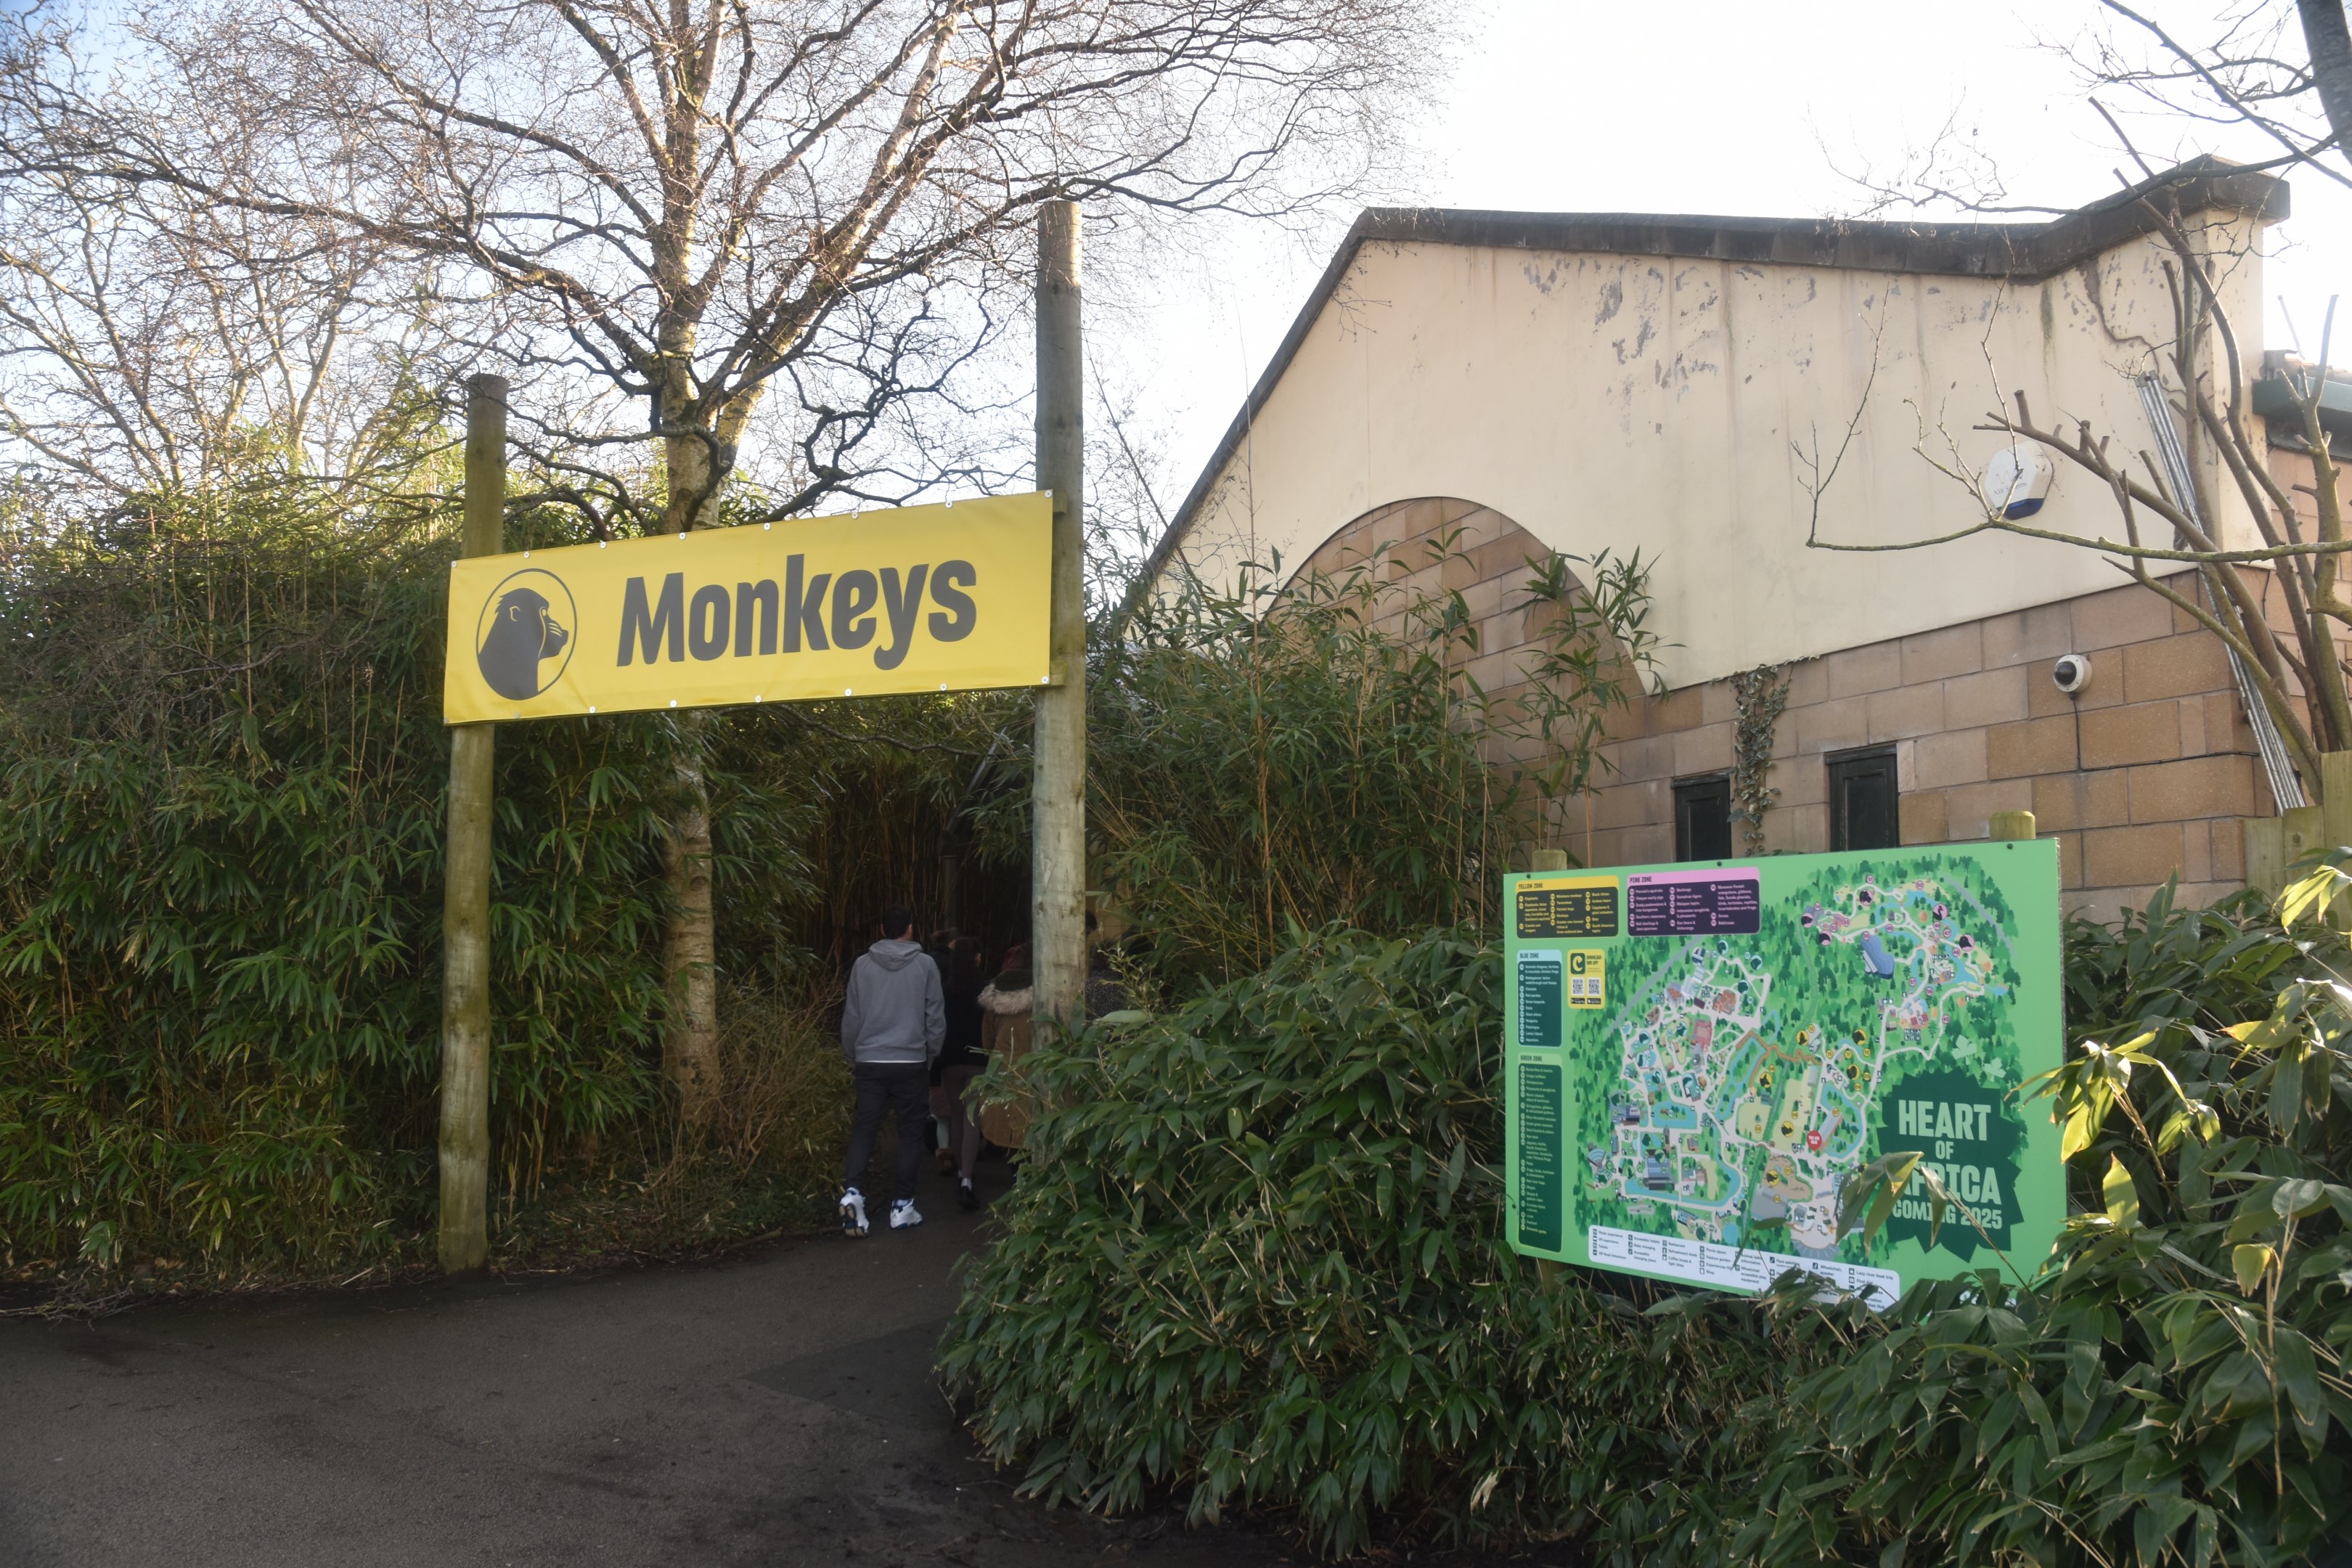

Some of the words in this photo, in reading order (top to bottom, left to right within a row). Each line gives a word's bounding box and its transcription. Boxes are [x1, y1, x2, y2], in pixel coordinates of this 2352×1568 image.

[617, 553, 977, 670] Monkeys
[1898, 1099, 1991, 1141] HEART
[1935, 1140, 1954, 1159] OF
[1903, 1161, 2002, 1205] FICA
[1892, 1199, 1956, 1224] COMIG
[1961, 1206, 2002, 1229] 2025
